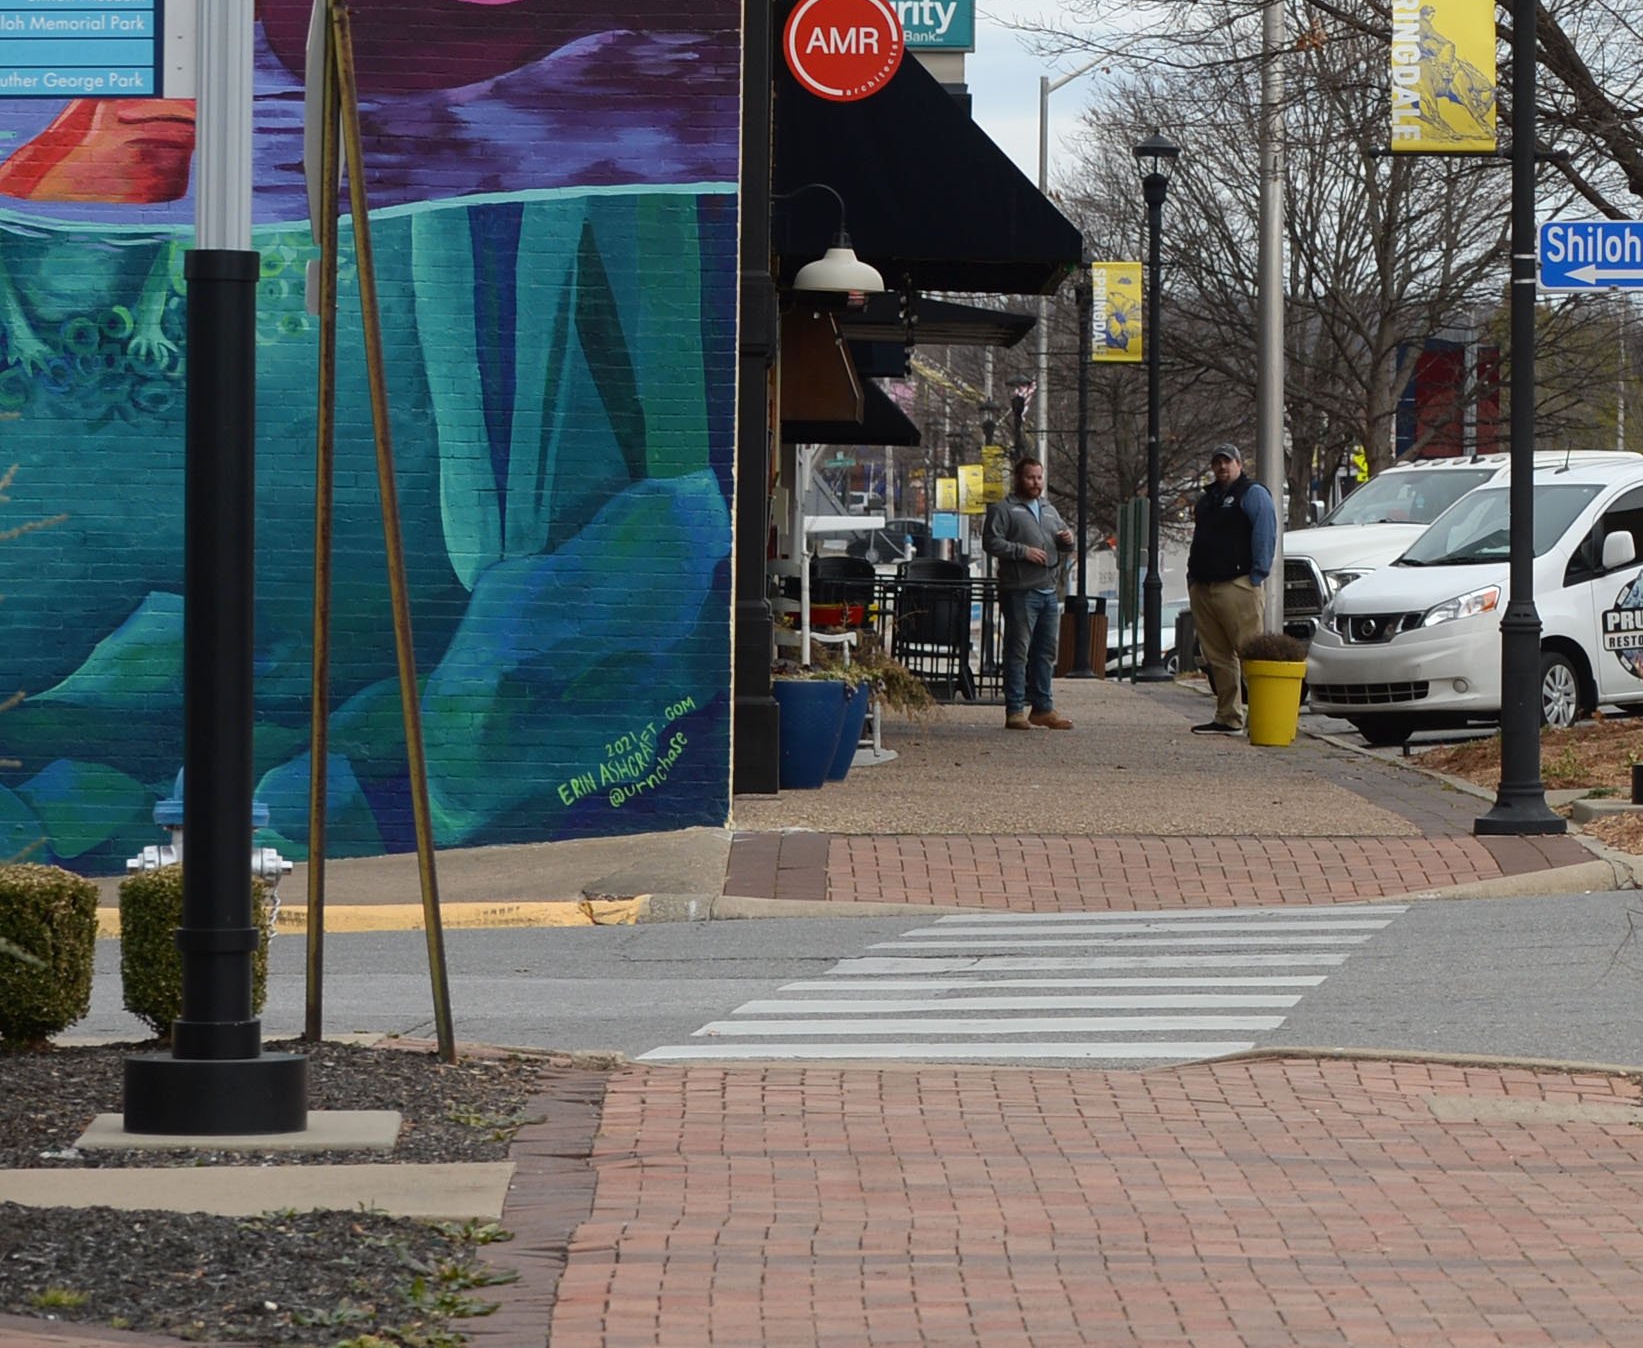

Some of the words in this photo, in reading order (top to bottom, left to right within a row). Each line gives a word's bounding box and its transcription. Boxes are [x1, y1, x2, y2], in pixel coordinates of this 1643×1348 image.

[29, 15, 105, 30] Memorial
[111, 15, 145, 30] Park
[903, 30, 937, 42] Bank
[805, 26, 879, 54] AMR
[43, 73, 103, 91] George
[109, 73, 143, 87] Park
[846, 44, 898, 96] architects
[1547, 226, 1641, 263] Shiloh
[605, 731, 637, 757] 2021
[609, 731, 688, 808] @urnchase
[557, 771, 597, 806] ERIN
